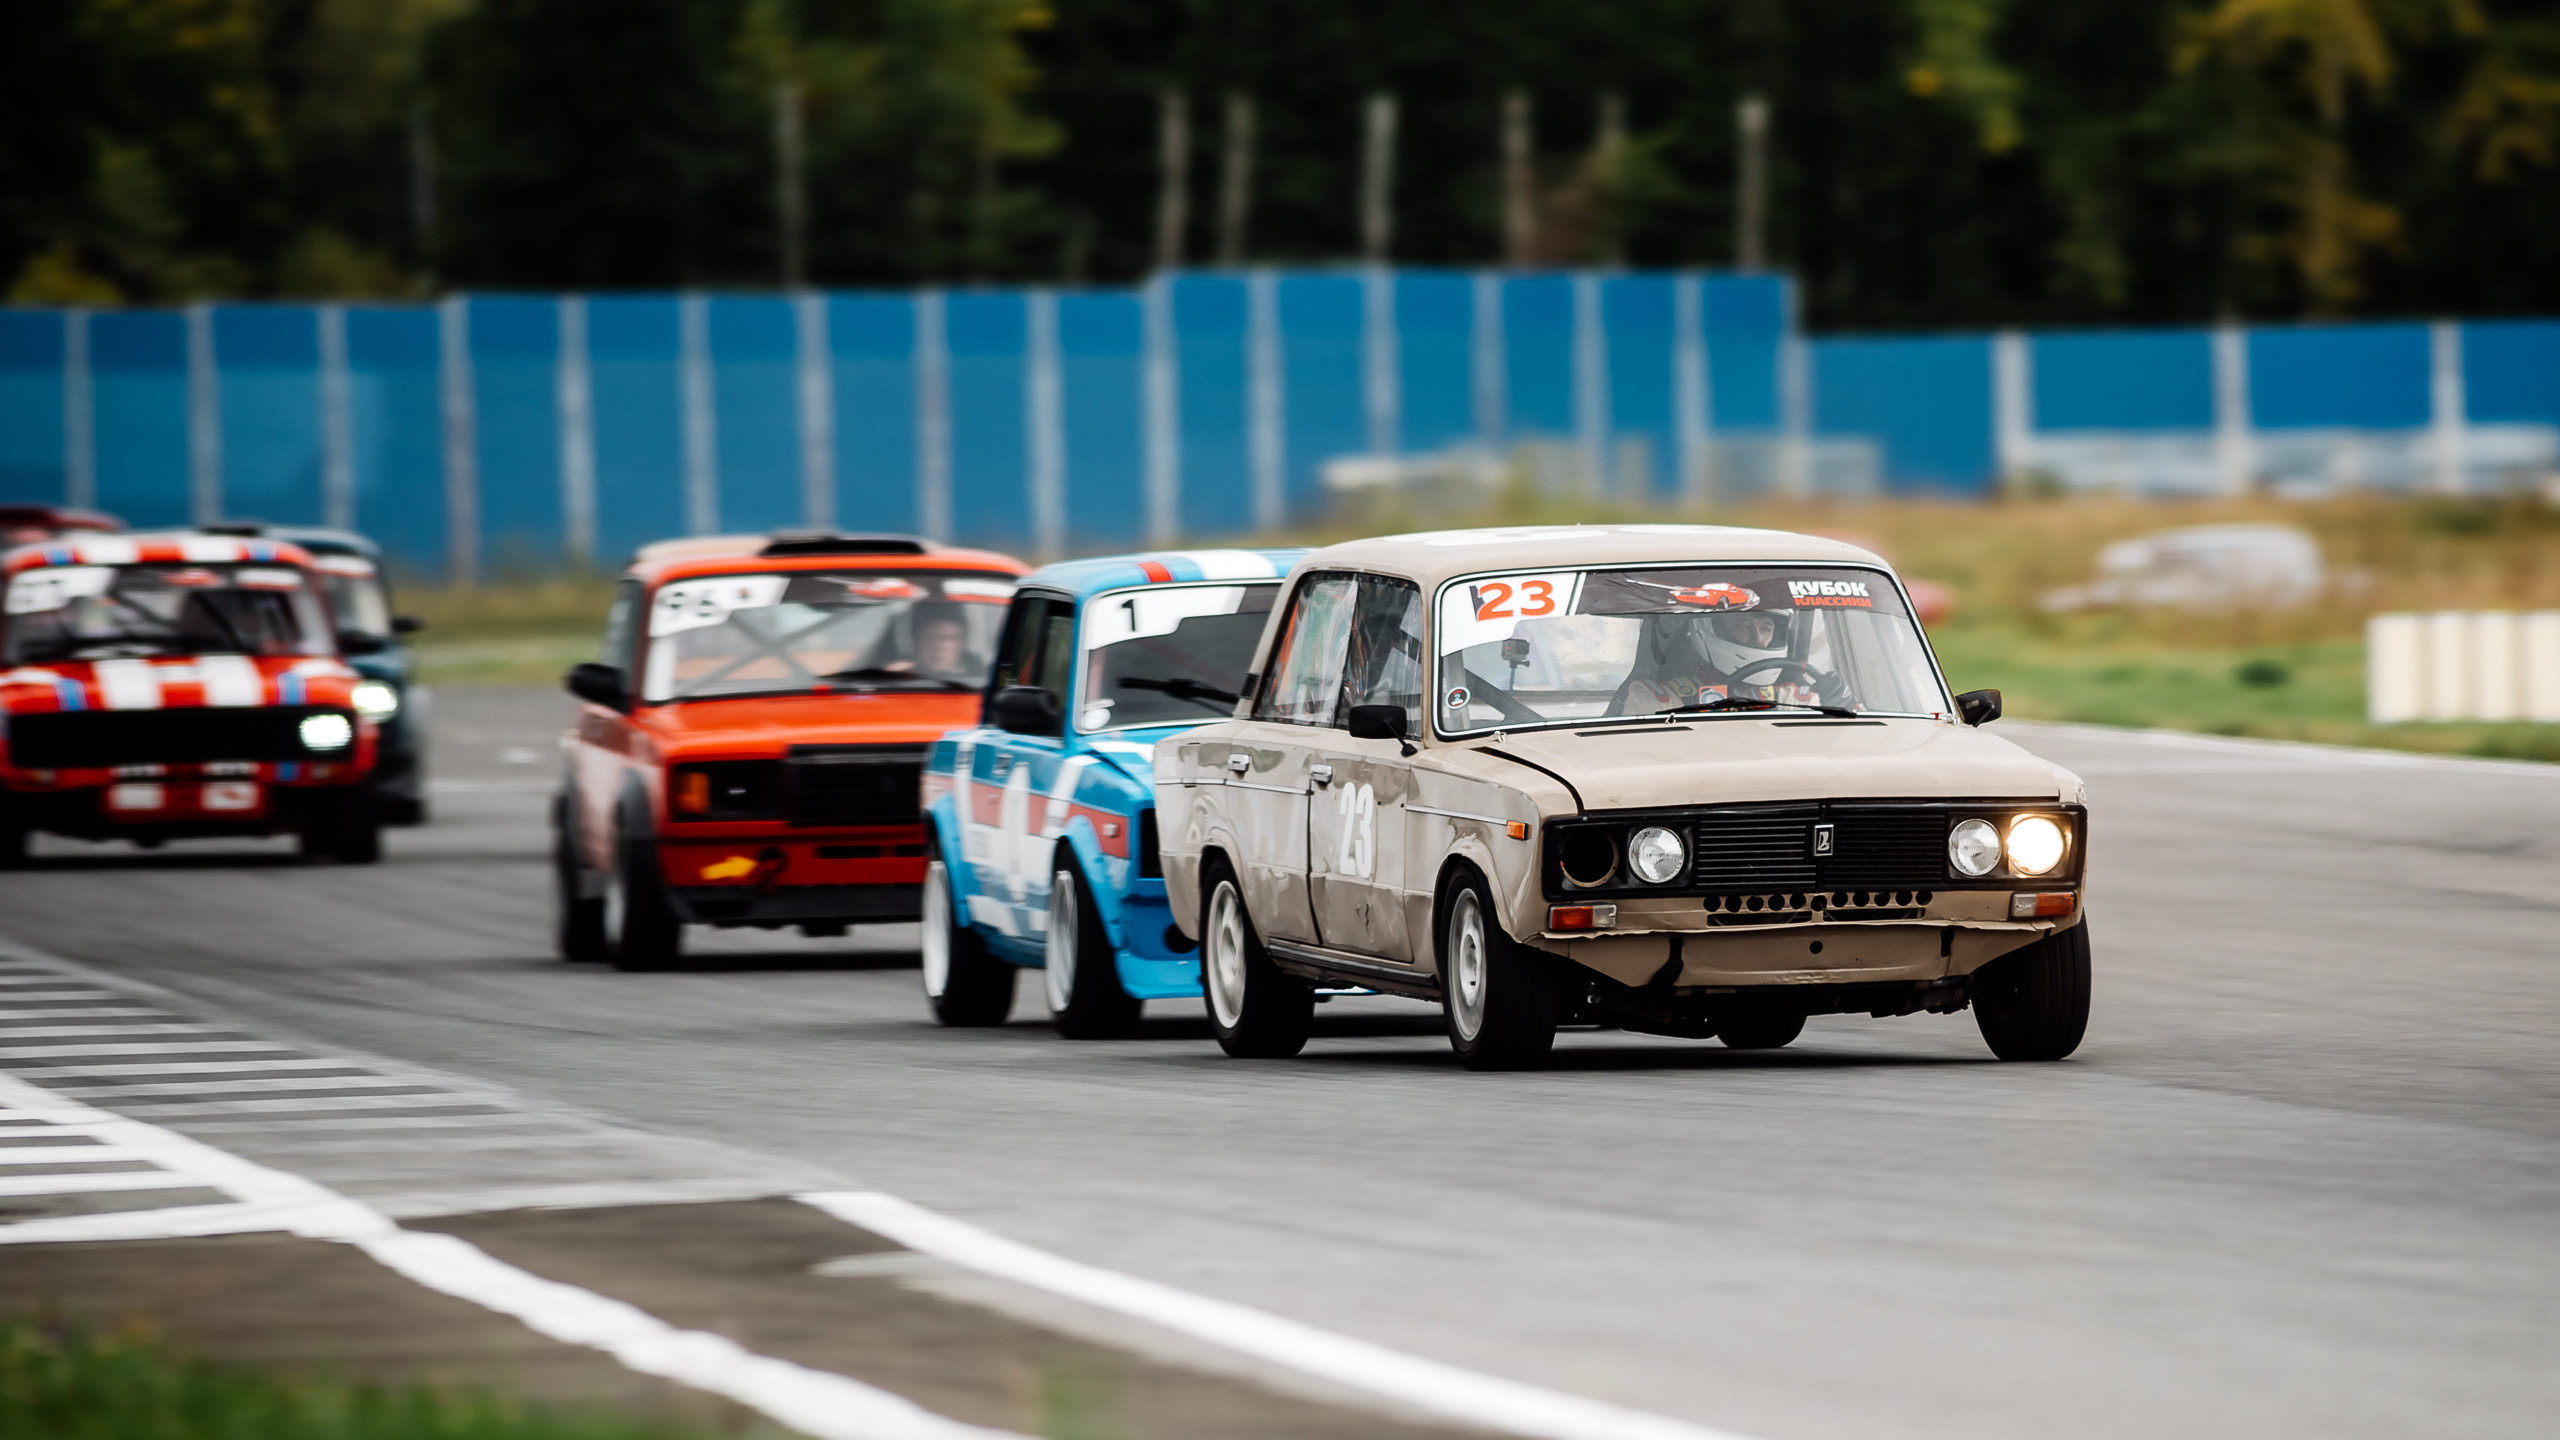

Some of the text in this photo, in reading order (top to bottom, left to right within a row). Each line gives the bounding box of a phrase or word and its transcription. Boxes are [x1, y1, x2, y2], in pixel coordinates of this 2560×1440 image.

[1478, 580, 1556, 621] 23
[1787, 580, 1870, 597] КУБОК
[1793, 596, 1873, 608] КЛАССИКИ
[1121, 598, 1136, 632] 1
[1339, 781, 1374, 879] 23
